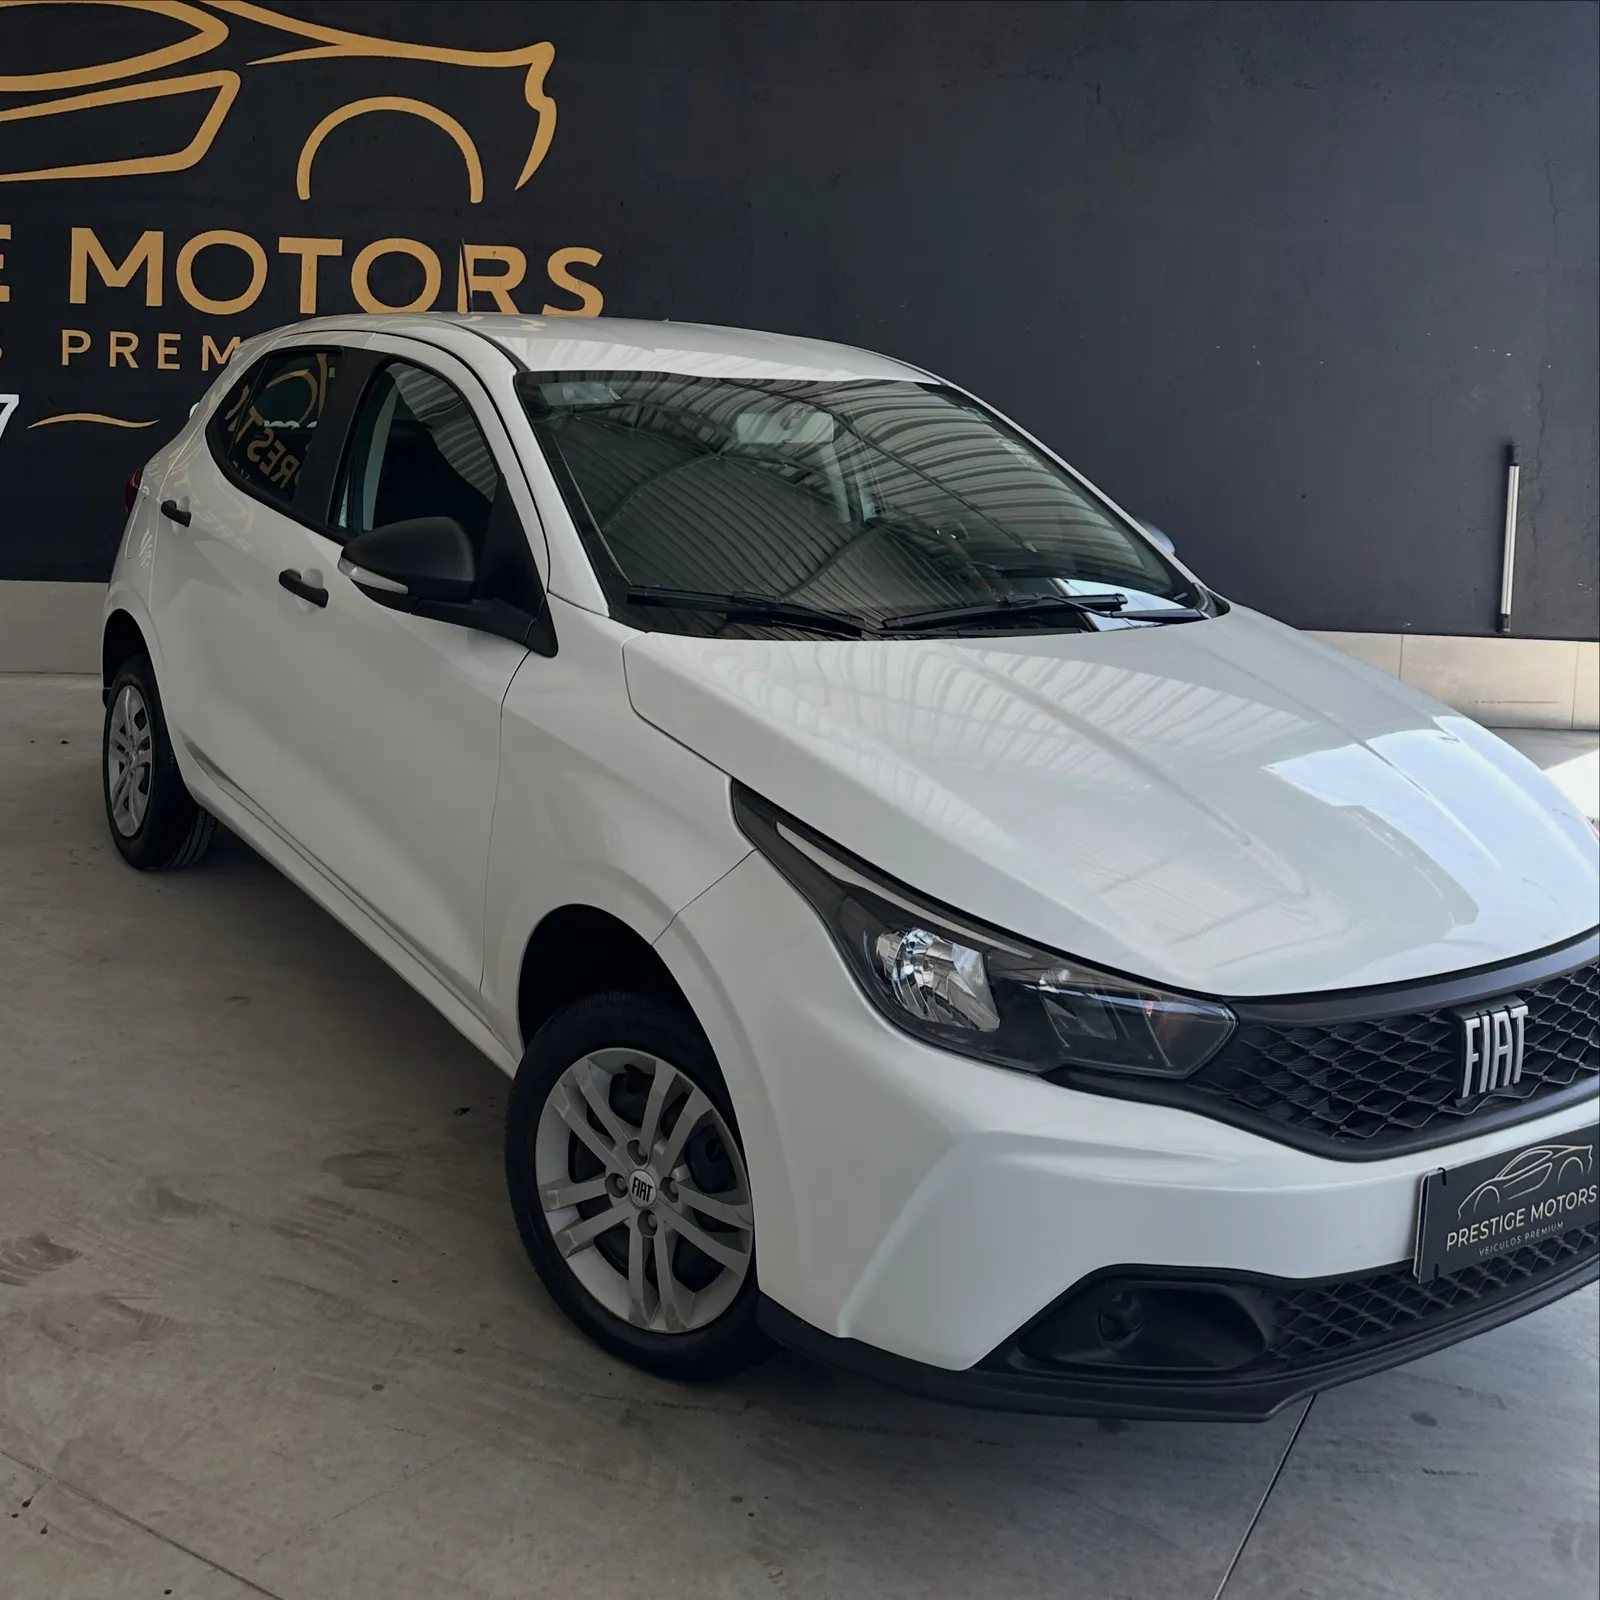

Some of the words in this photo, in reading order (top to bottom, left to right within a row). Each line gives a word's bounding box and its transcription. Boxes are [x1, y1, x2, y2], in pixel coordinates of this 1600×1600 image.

[69, 228, 604, 318] MOTORS
[1462, 1005, 1528, 1098] FIAT
[631, 1177, 653, 1202] FIAT
[1446, 1208, 1526, 1251] PRESTIGE
[1531, 1184, 1598, 1222] MOTORS
[1524, 1221, 1564, 1241] PREMIUM
